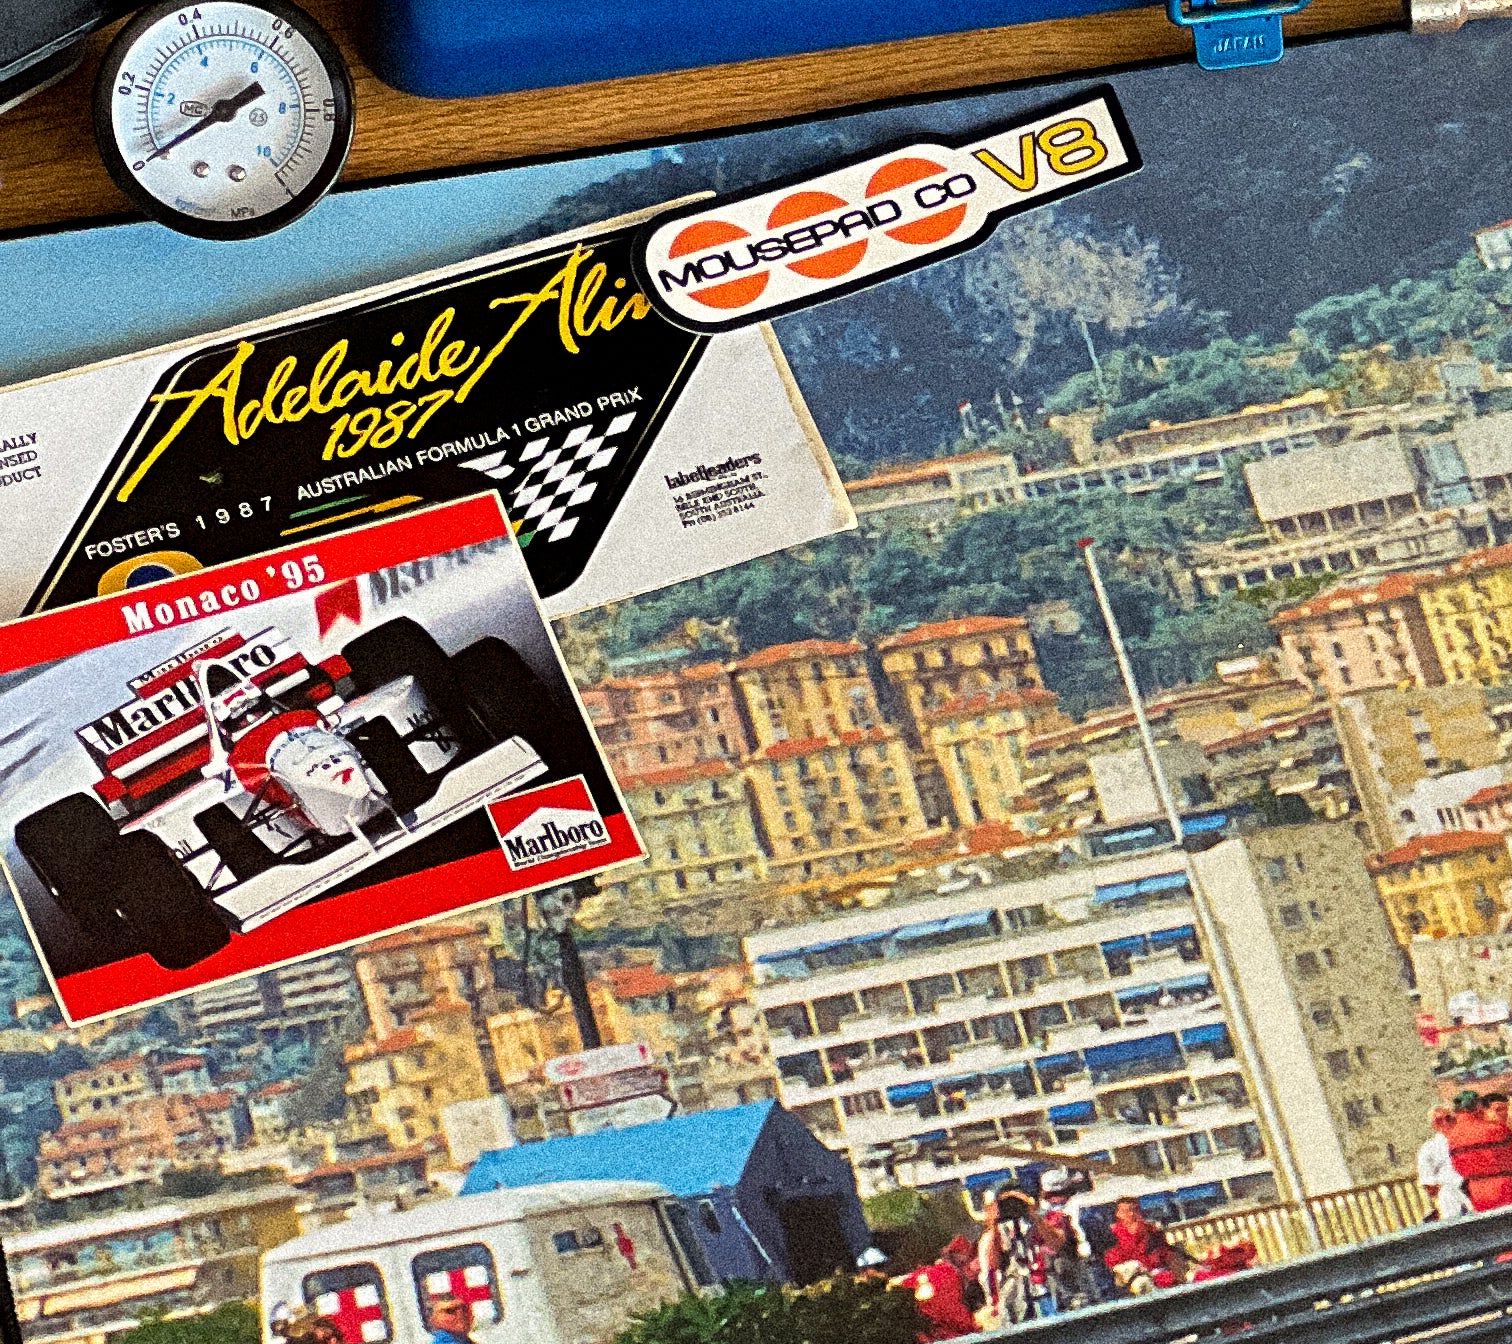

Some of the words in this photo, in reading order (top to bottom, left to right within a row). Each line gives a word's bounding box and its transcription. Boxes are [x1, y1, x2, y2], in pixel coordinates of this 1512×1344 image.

[178, 8, 202, 26] 0.4
[271, 18, 294, 39] 0.6
[200, 56, 209, 68] 4
[250, 61, 259, 74] 6
[118, 71, 136, 96] 0.2
[166, 93, 176, 105] 2
[322, 98, 337, 122] 0.8
[256, 145, 272, 157] 10
[132, 160, 145, 171] 0
[657, 197, 903, 294] MOUSEPAD
[914, 172, 977, 210] CO
[972, 117, 1110, 193] V8
[116, 306, 481, 504] Adelaide
[320, 387, 455, 462] 1987
[0, 432, 37, 453] ALLY
[84, 522, 181, 560] FOSTER'S
[297, 455, 413, 501] AUSTRALIAN
[415, 427, 511, 466] FORMULA
[524, 401, 593, 433] GRAND
[121, 578, 262, 635] Monaco
[265, 553, 326, 590] '95
[503, 819, 605, 862] Marlboro
